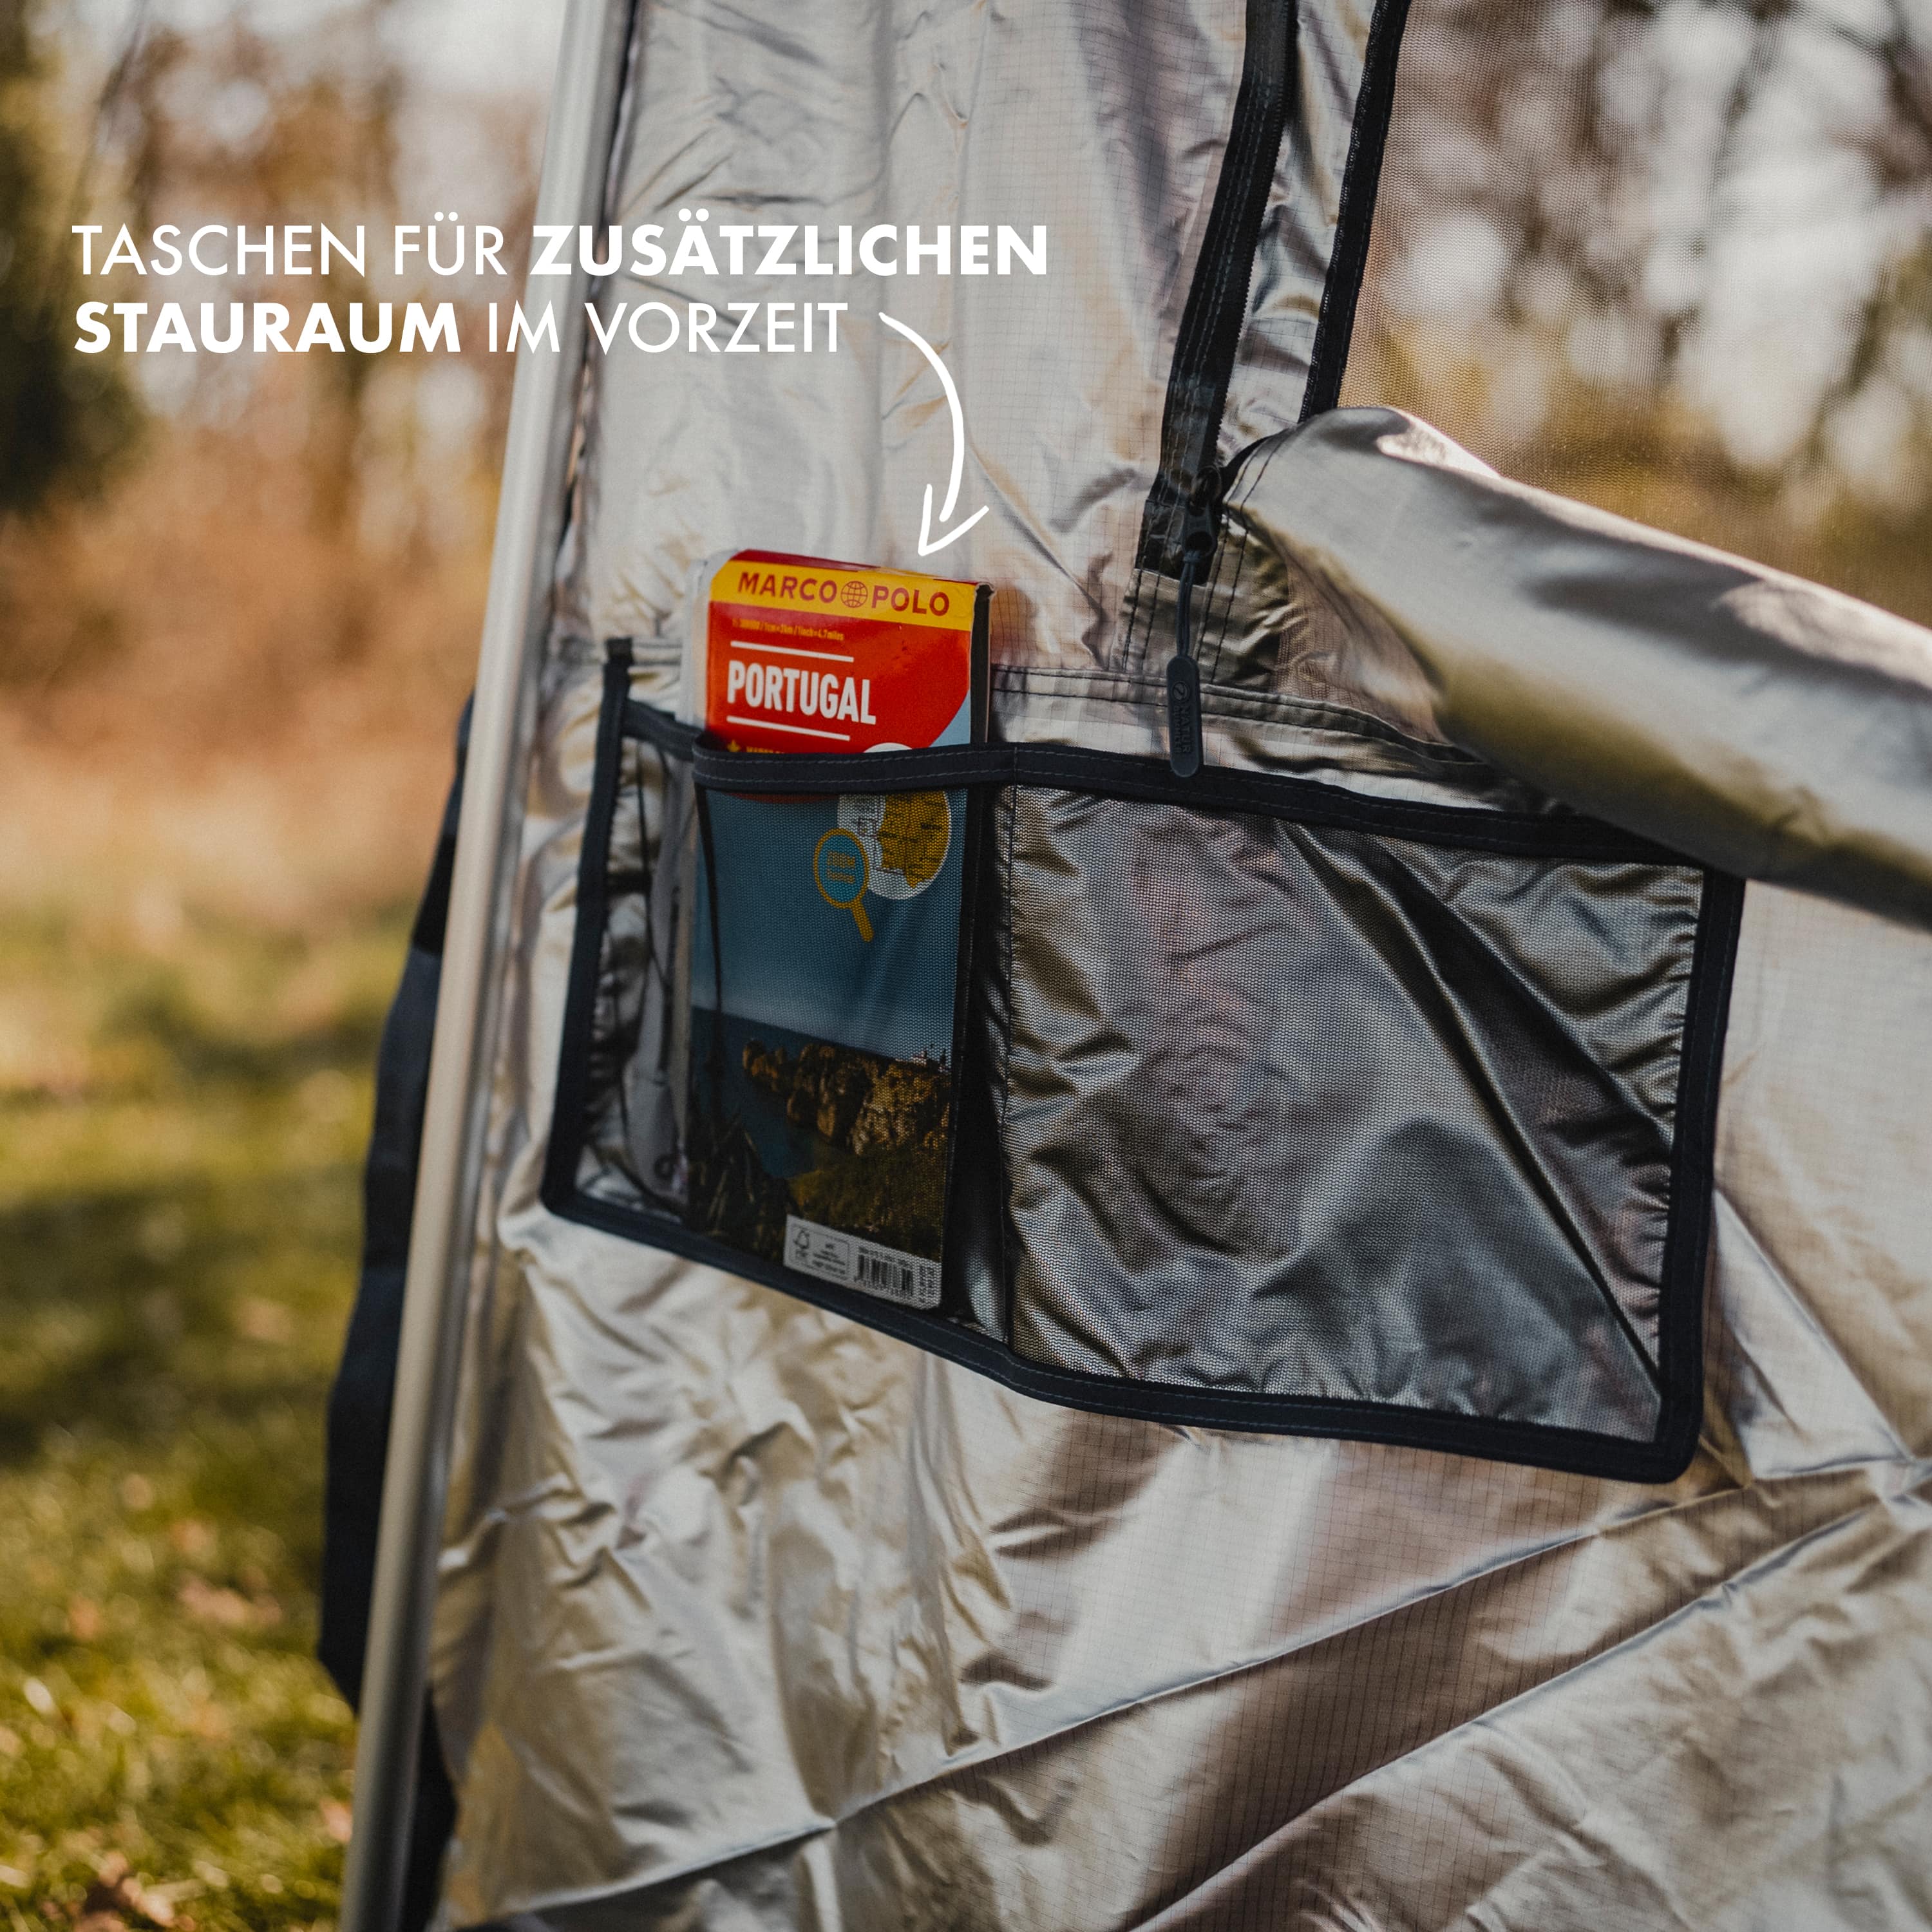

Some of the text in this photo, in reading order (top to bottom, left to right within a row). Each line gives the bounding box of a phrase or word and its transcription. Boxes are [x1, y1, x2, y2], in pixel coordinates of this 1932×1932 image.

[737, 571, 950, 616] MARCO POLO
[726, 659, 876, 725] PORTUGAL
[1181, 705, 1191, 753] NATUR
